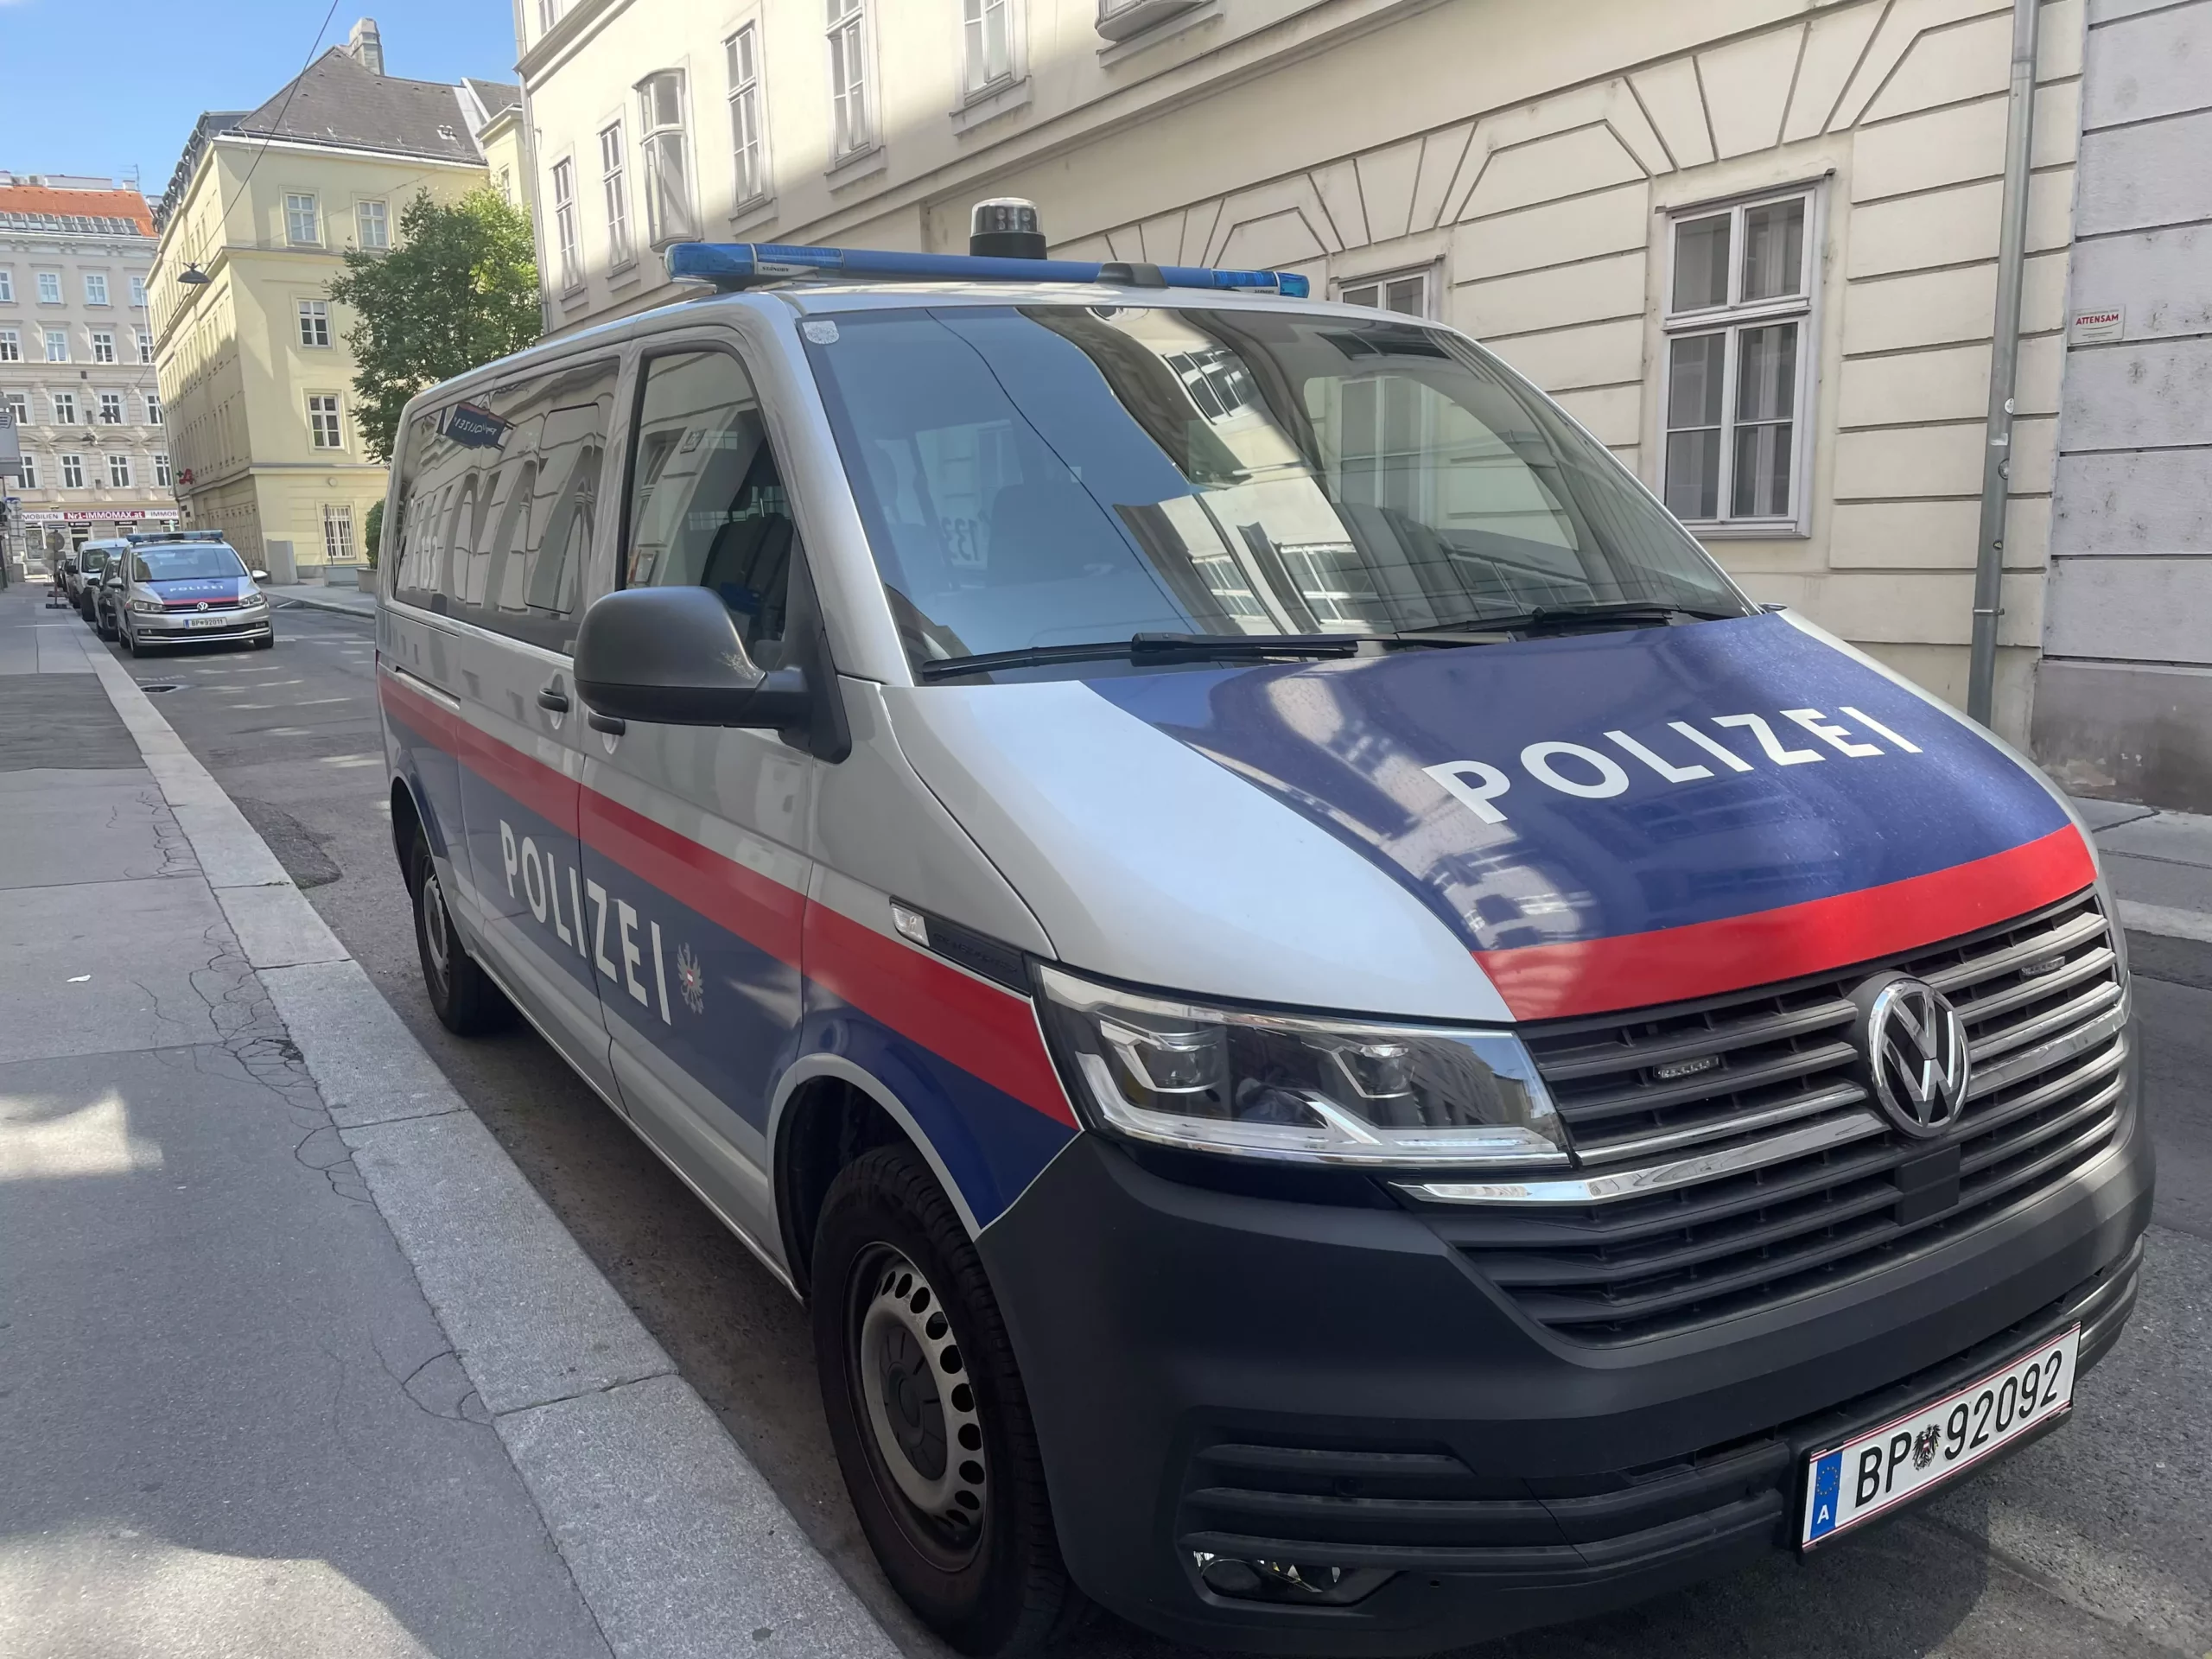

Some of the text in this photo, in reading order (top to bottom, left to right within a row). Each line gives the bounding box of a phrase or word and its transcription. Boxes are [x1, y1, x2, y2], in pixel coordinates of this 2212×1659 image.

[2075, 314, 2119, 325] ATTENSAM
[1421, 706, 1923, 824] POLIZEI
[499, 819, 671, 1026] POLIZEI
[1816, 1349, 2063, 1525] A BP 92092
